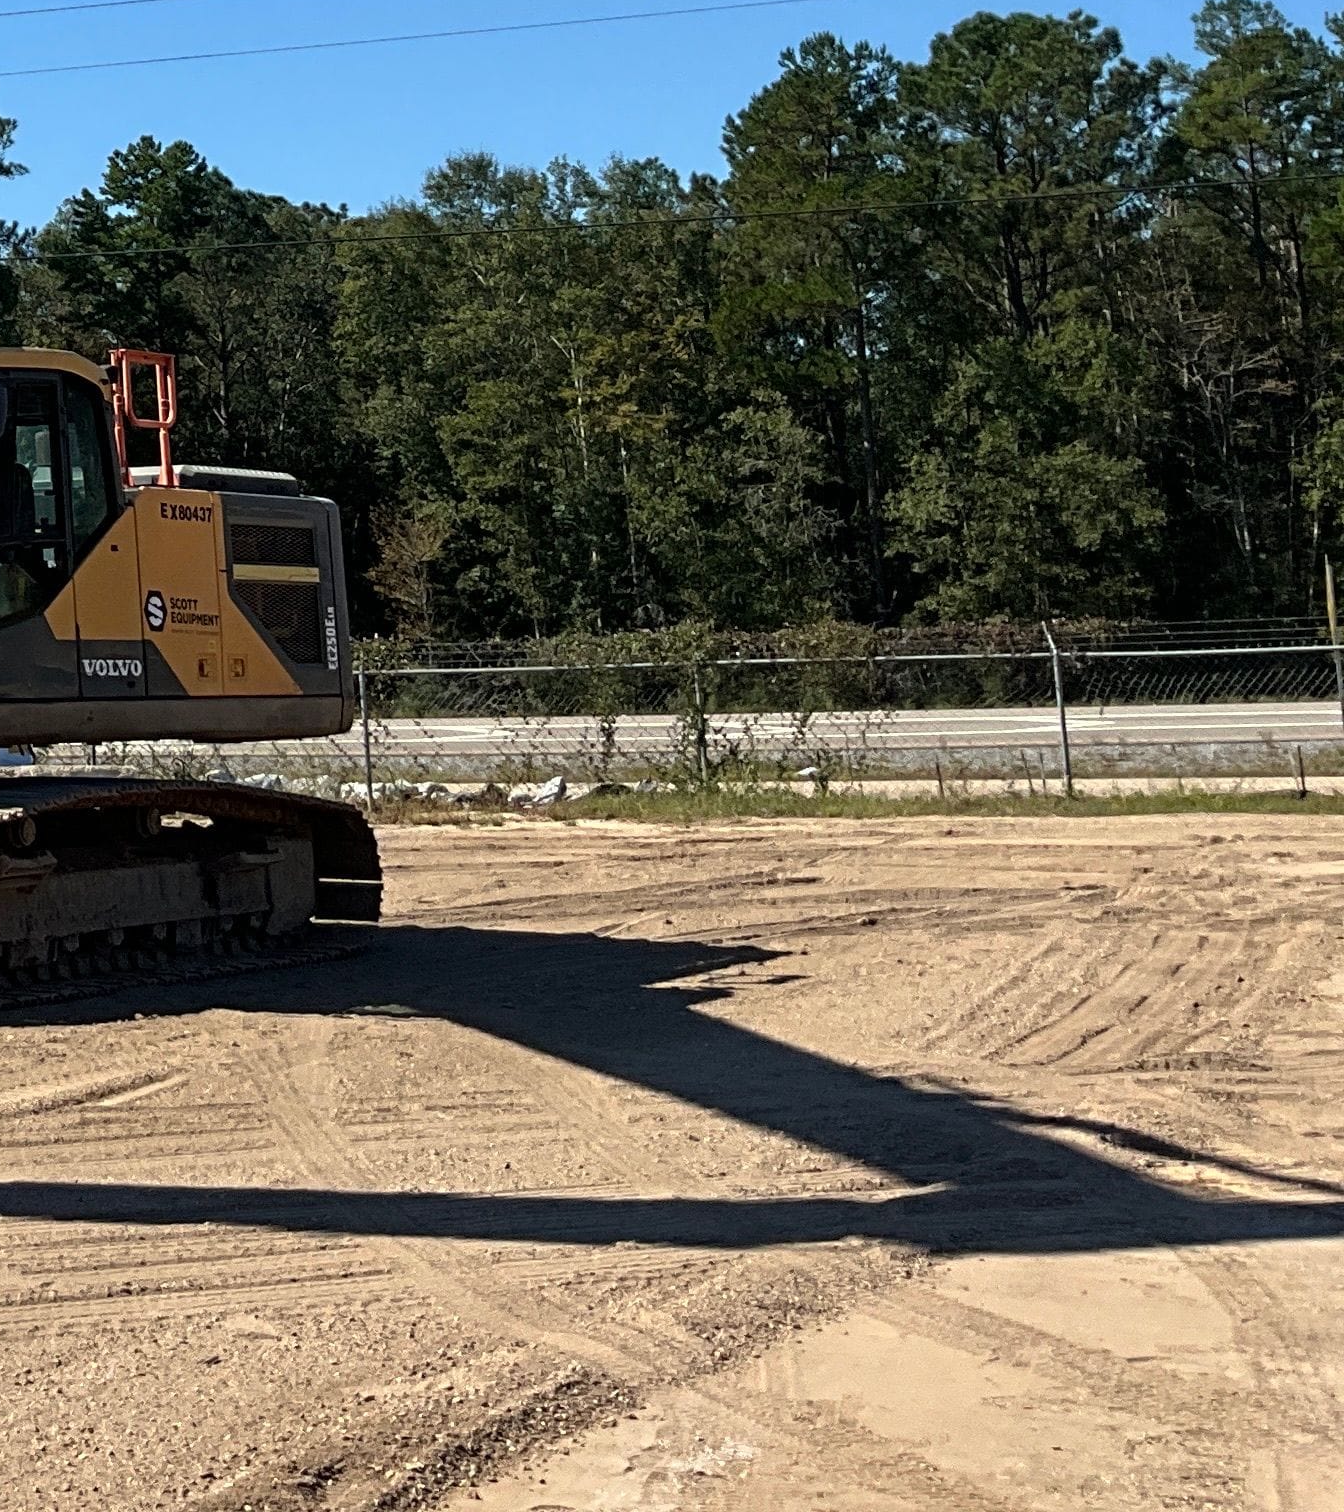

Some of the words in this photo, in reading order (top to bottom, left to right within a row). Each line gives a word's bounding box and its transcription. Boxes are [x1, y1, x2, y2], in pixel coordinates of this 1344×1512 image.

[160, 502, 212, 523] EX80437
[170, 597, 198, 611] SCOTT
[171, 612, 219, 626] EQUIPMENT
[81, 658, 143, 677] VOLVO
